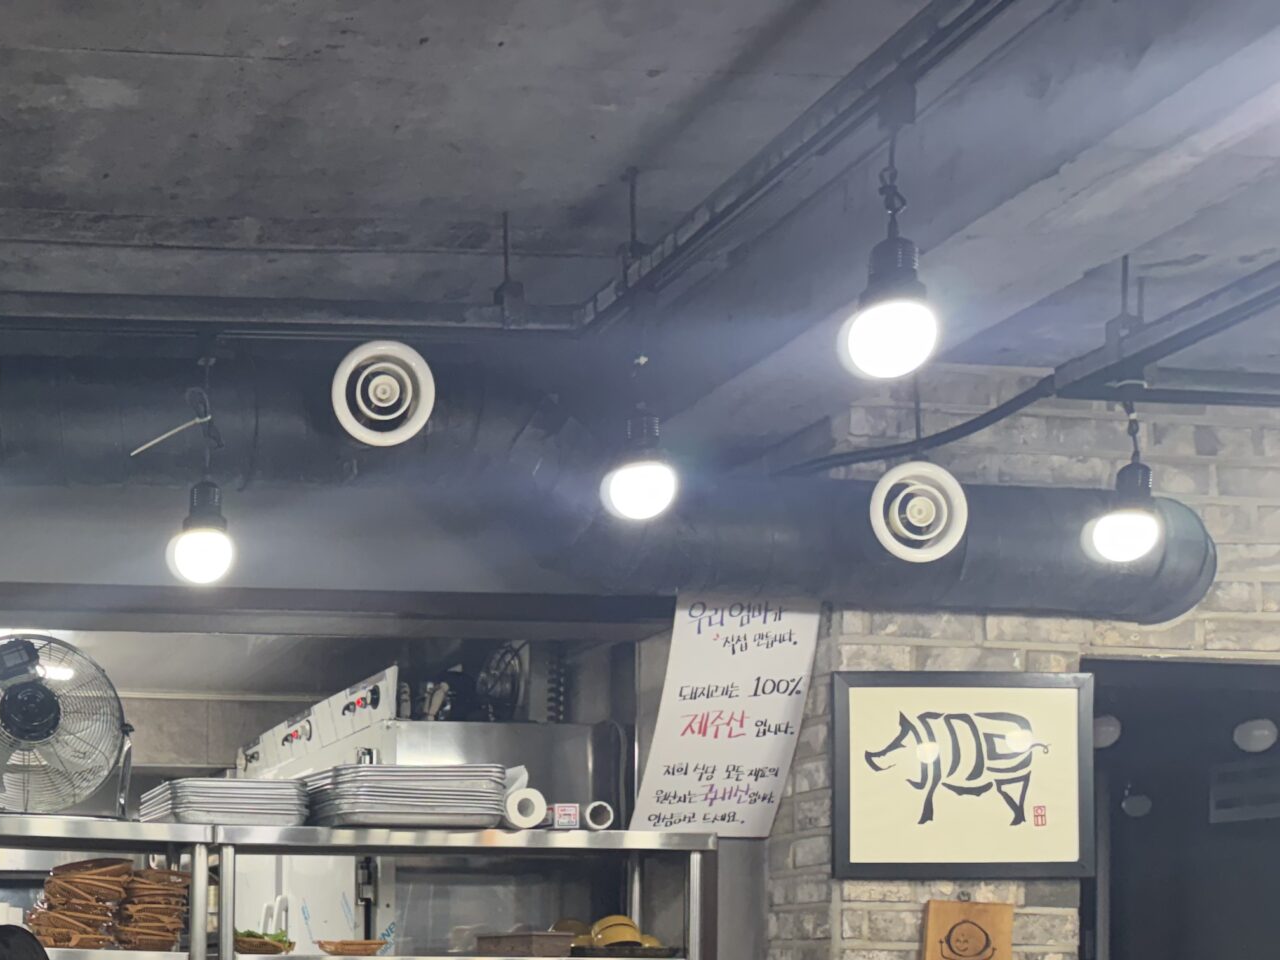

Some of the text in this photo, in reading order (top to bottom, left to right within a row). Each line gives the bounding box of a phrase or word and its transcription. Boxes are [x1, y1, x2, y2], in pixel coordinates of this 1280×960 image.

[688, 600, 784, 634] 우리 엄마가
[723, 629, 798, 655] 직접 만듭니다.
[678, 675, 803, 701] 돼지고기는 100%
[680, 709, 795, 739] 제주산 입니다.
[663, 762, 779, 782] 저희 식당 모든 재료의
[653, 789, 697, 805] 원산지는
[647, 811, 745, 828] 안심하고 드세요.
